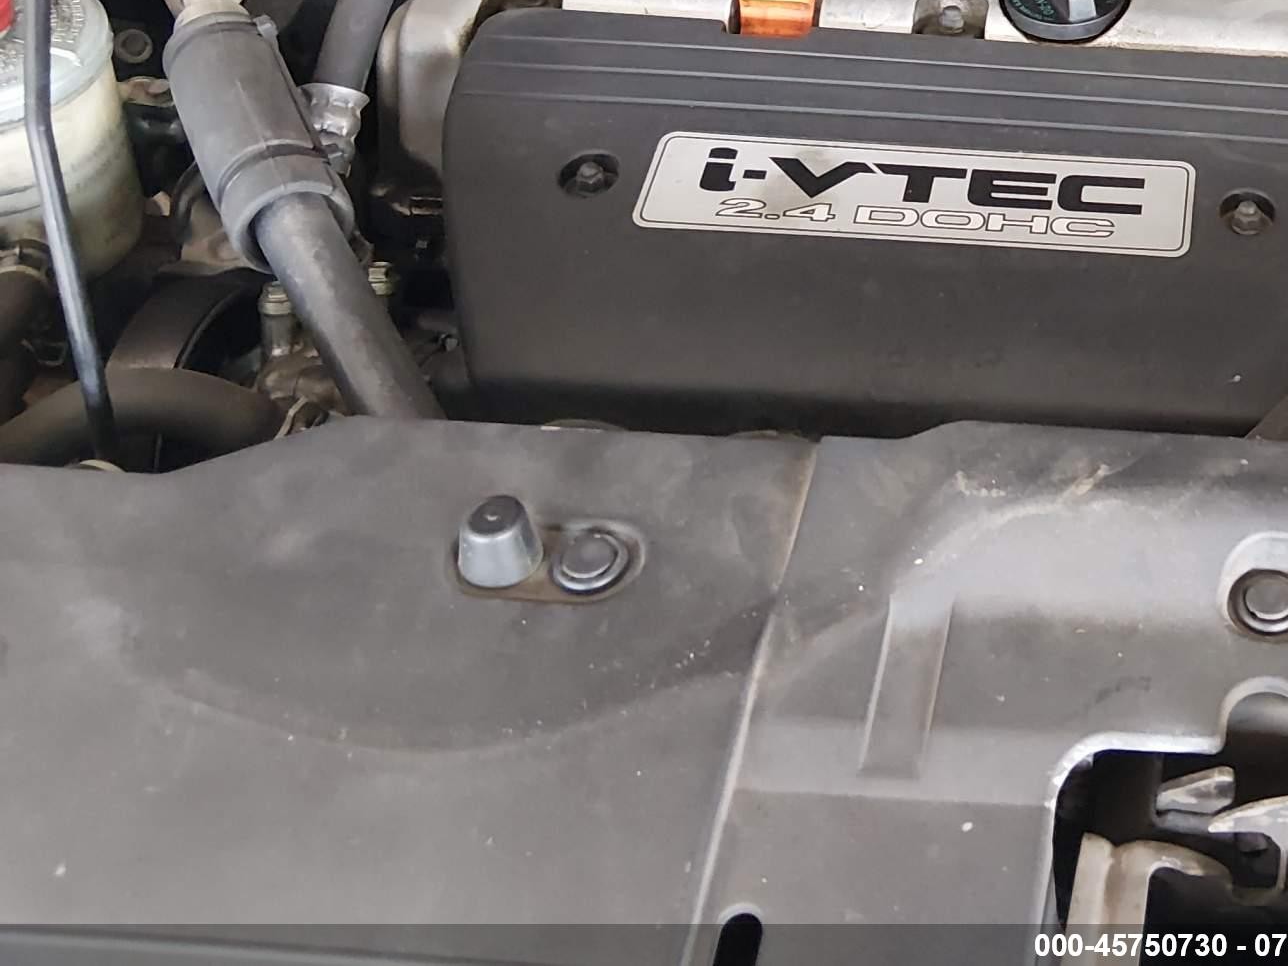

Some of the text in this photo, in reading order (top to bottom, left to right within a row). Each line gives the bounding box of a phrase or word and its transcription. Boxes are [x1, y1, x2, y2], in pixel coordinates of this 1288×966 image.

[700, 146, 1145, 216] i-VTEC
[715, 197, 1116, 238] 2.4 DOHC
